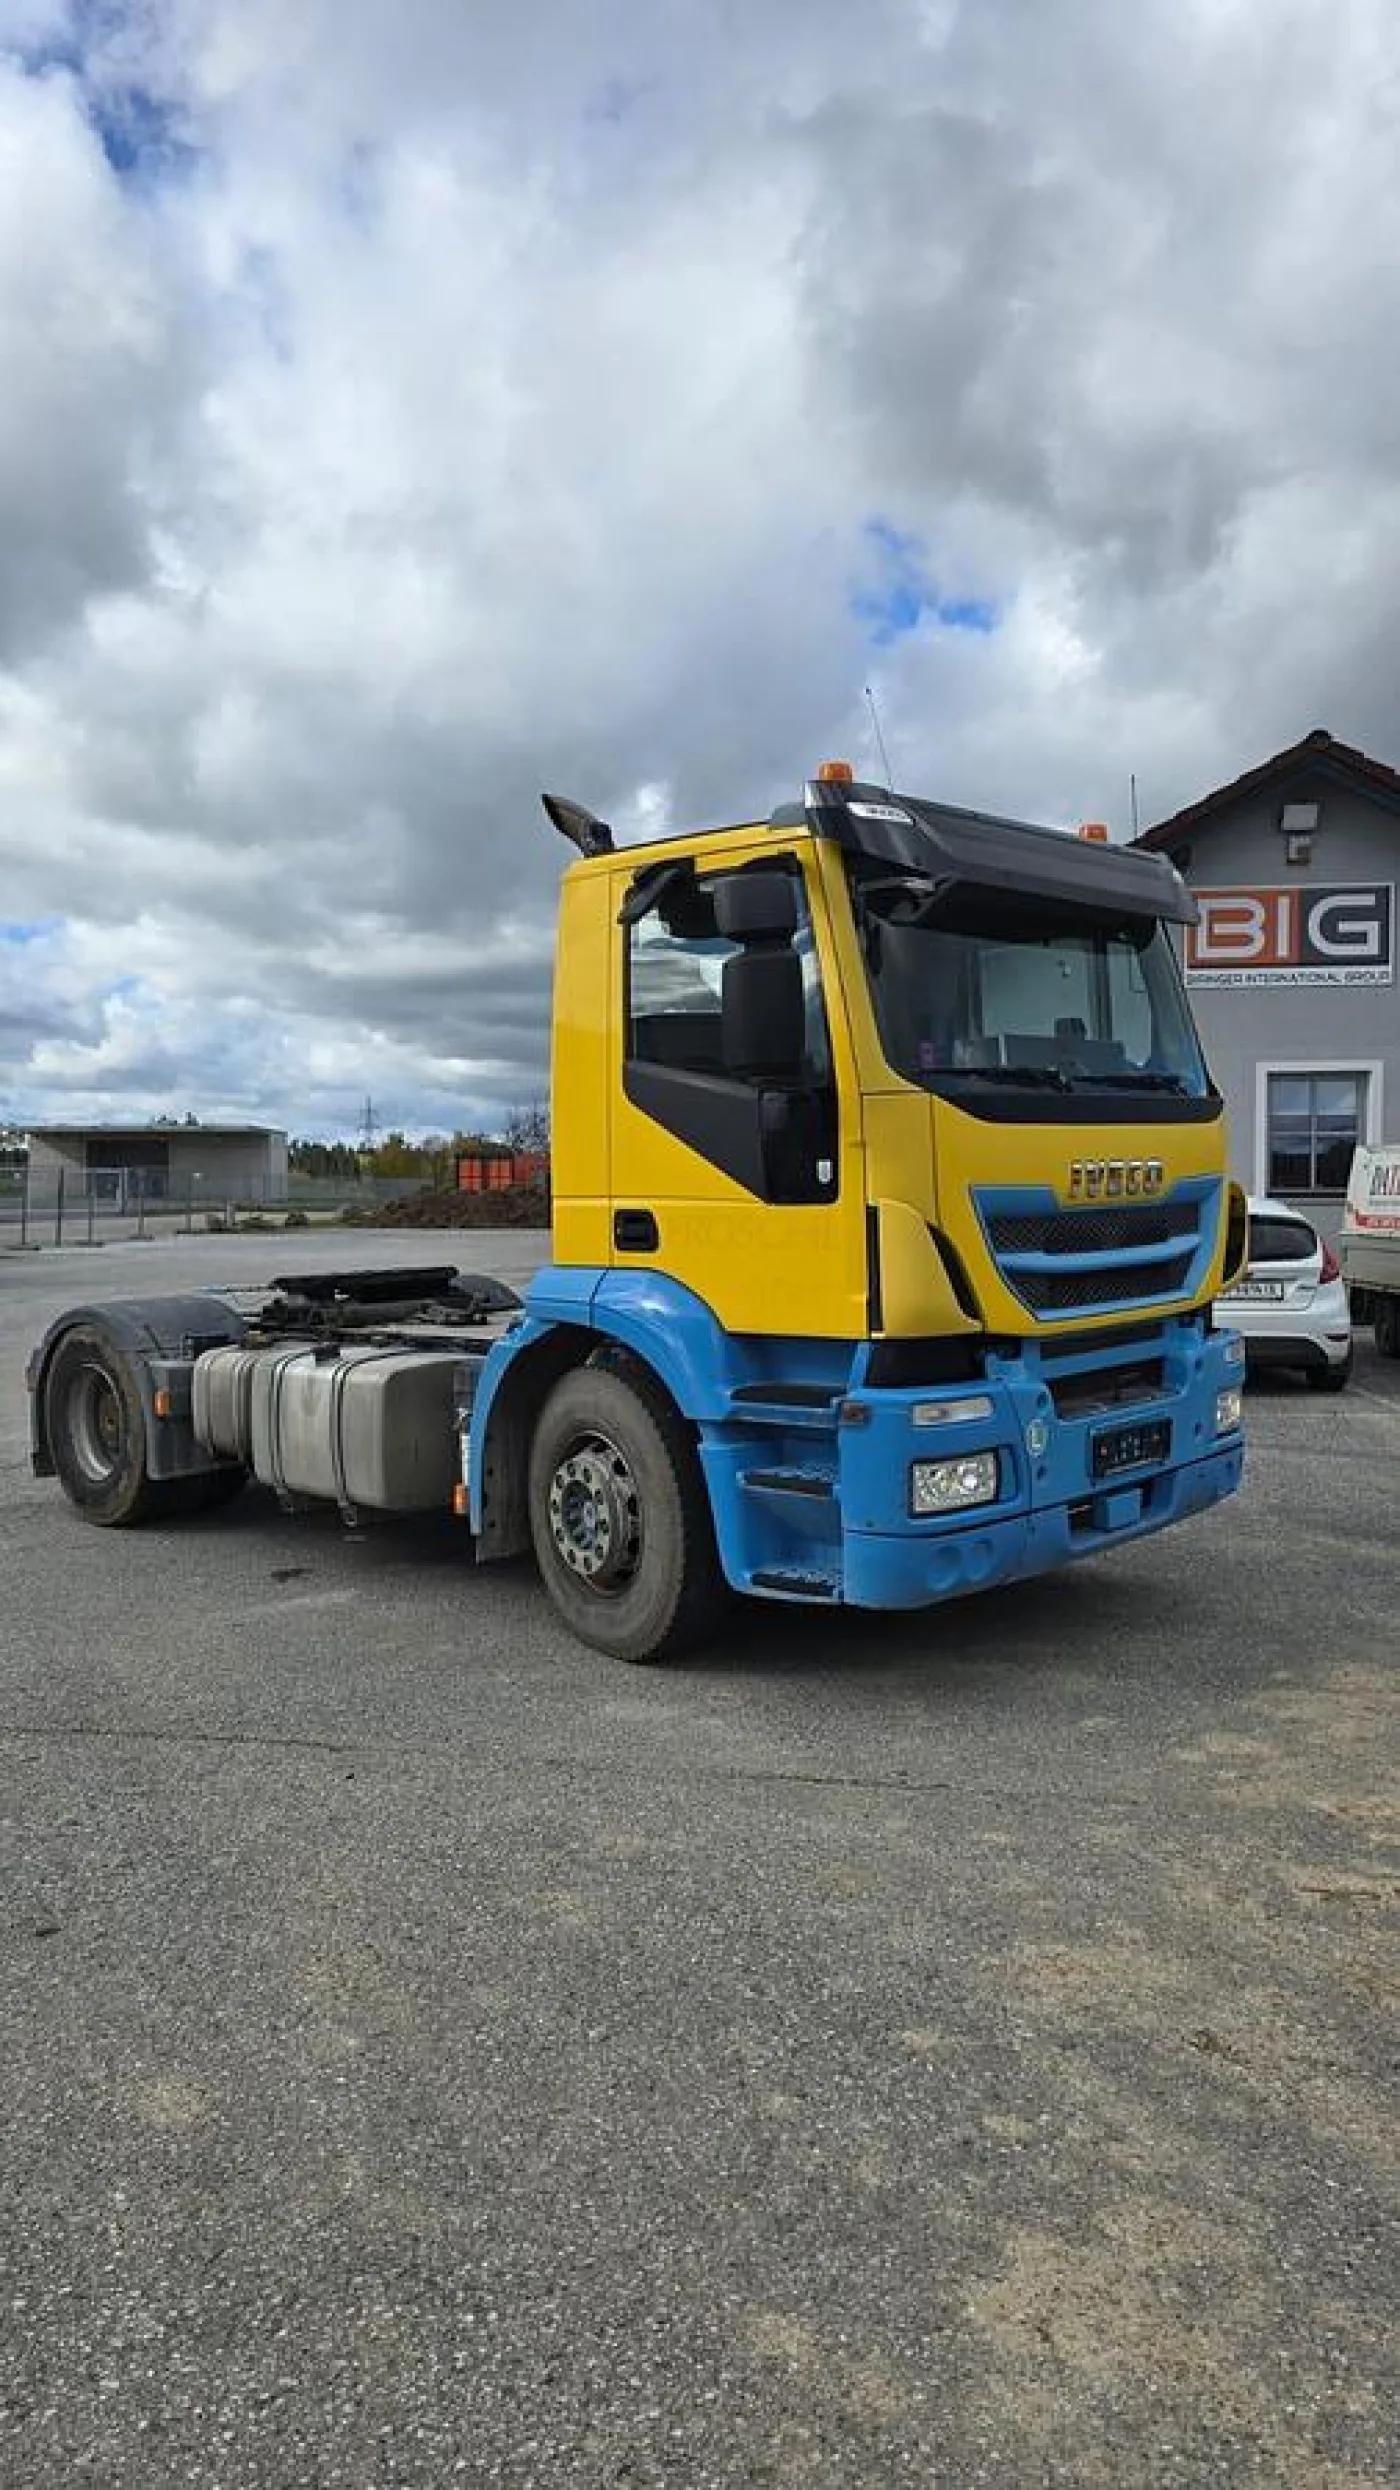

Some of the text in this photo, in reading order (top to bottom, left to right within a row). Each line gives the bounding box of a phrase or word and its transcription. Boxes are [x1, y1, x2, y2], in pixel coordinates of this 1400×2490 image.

[1197, 893, 1380, 959] BIG
[1245, 972, 1341, 985] INTERNATIONAL
[1344, 970, 1390, 984] GROUP
[1068, 1158, 1165, 1198] IVECO
